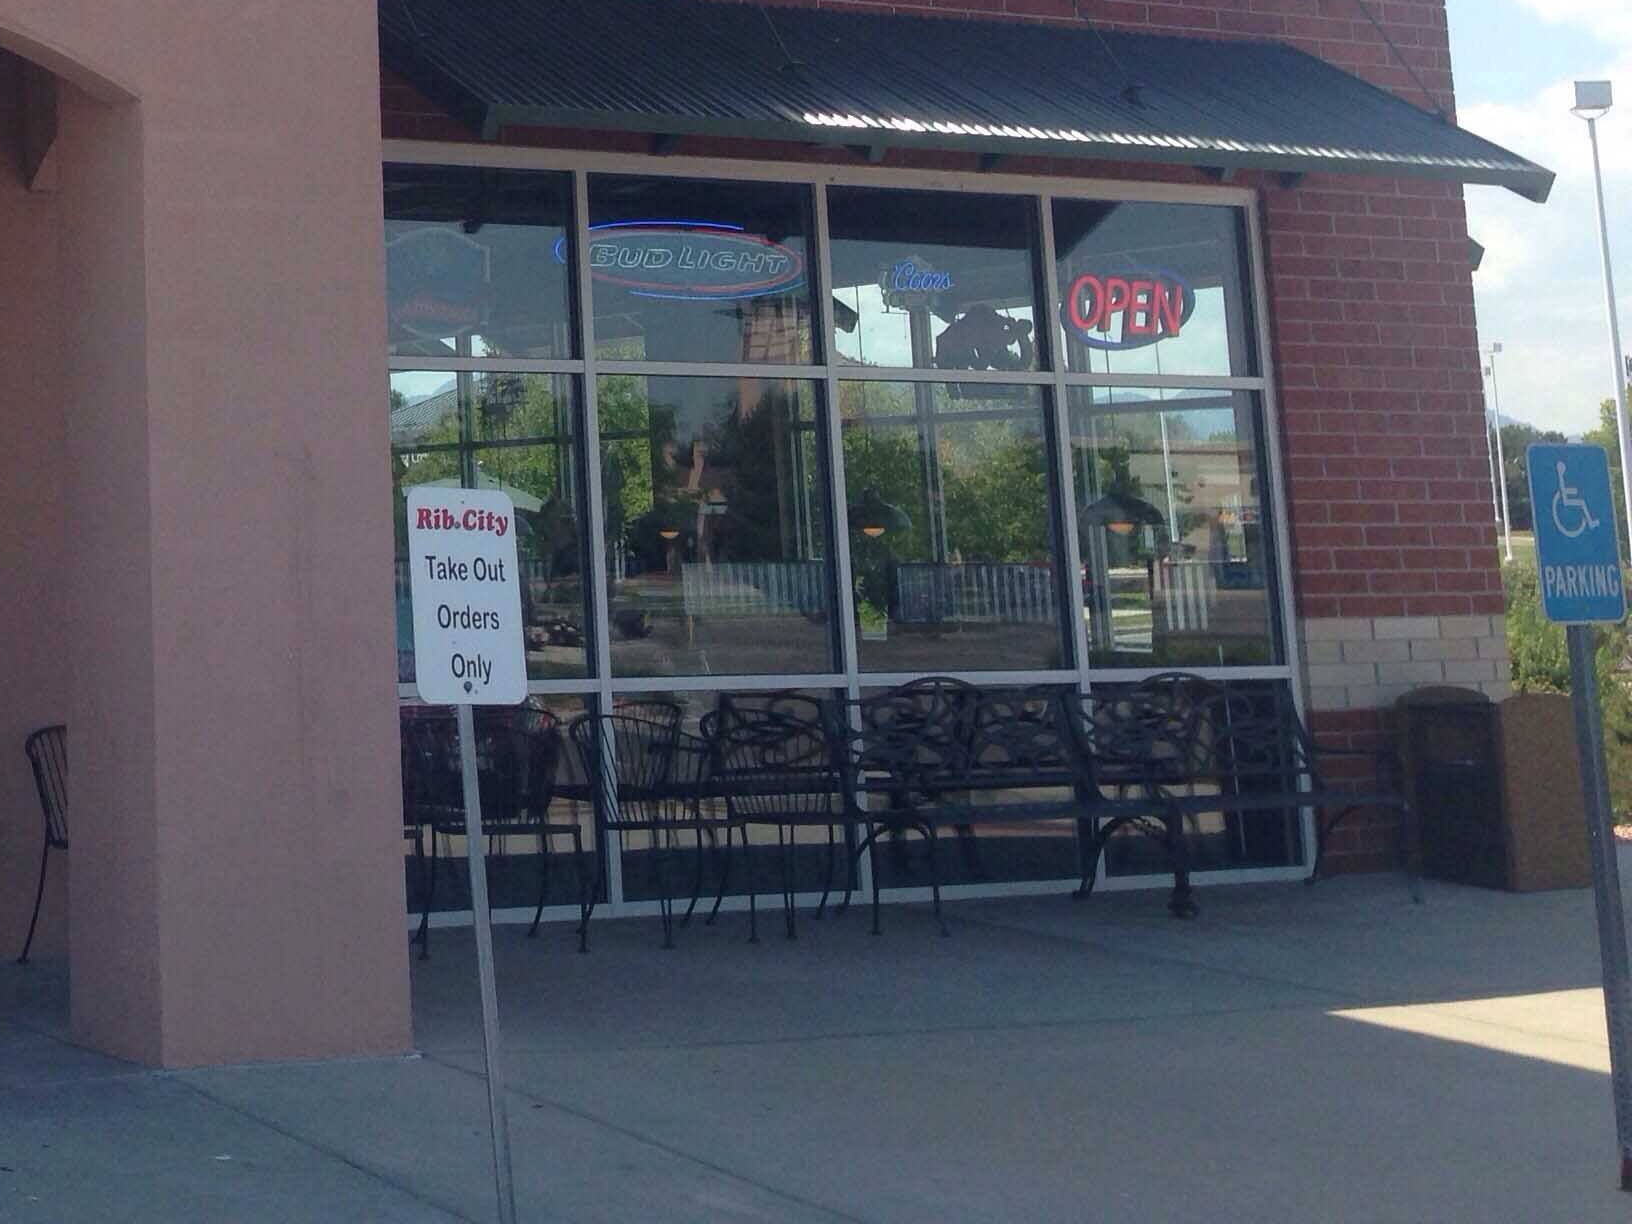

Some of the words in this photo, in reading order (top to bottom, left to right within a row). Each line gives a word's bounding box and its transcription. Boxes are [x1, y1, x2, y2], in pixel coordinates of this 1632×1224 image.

[589, 244, 673, 269] BUD
[678, 246, 787, 274] LIGHT
[892, 261, 952, 291] Coors
[1070, 273, 1183, 336] OPEN
[416, 508, 455, 530] Rib
[462, 509, 508, 536] City
[425, 555, 468, 581] Take
[473, 557, 506, 582] Out
[1544, 564, 1619, 599] PARKING
[437, 605, 500, 629] Orders
[451, 653, 492, 685] Only
